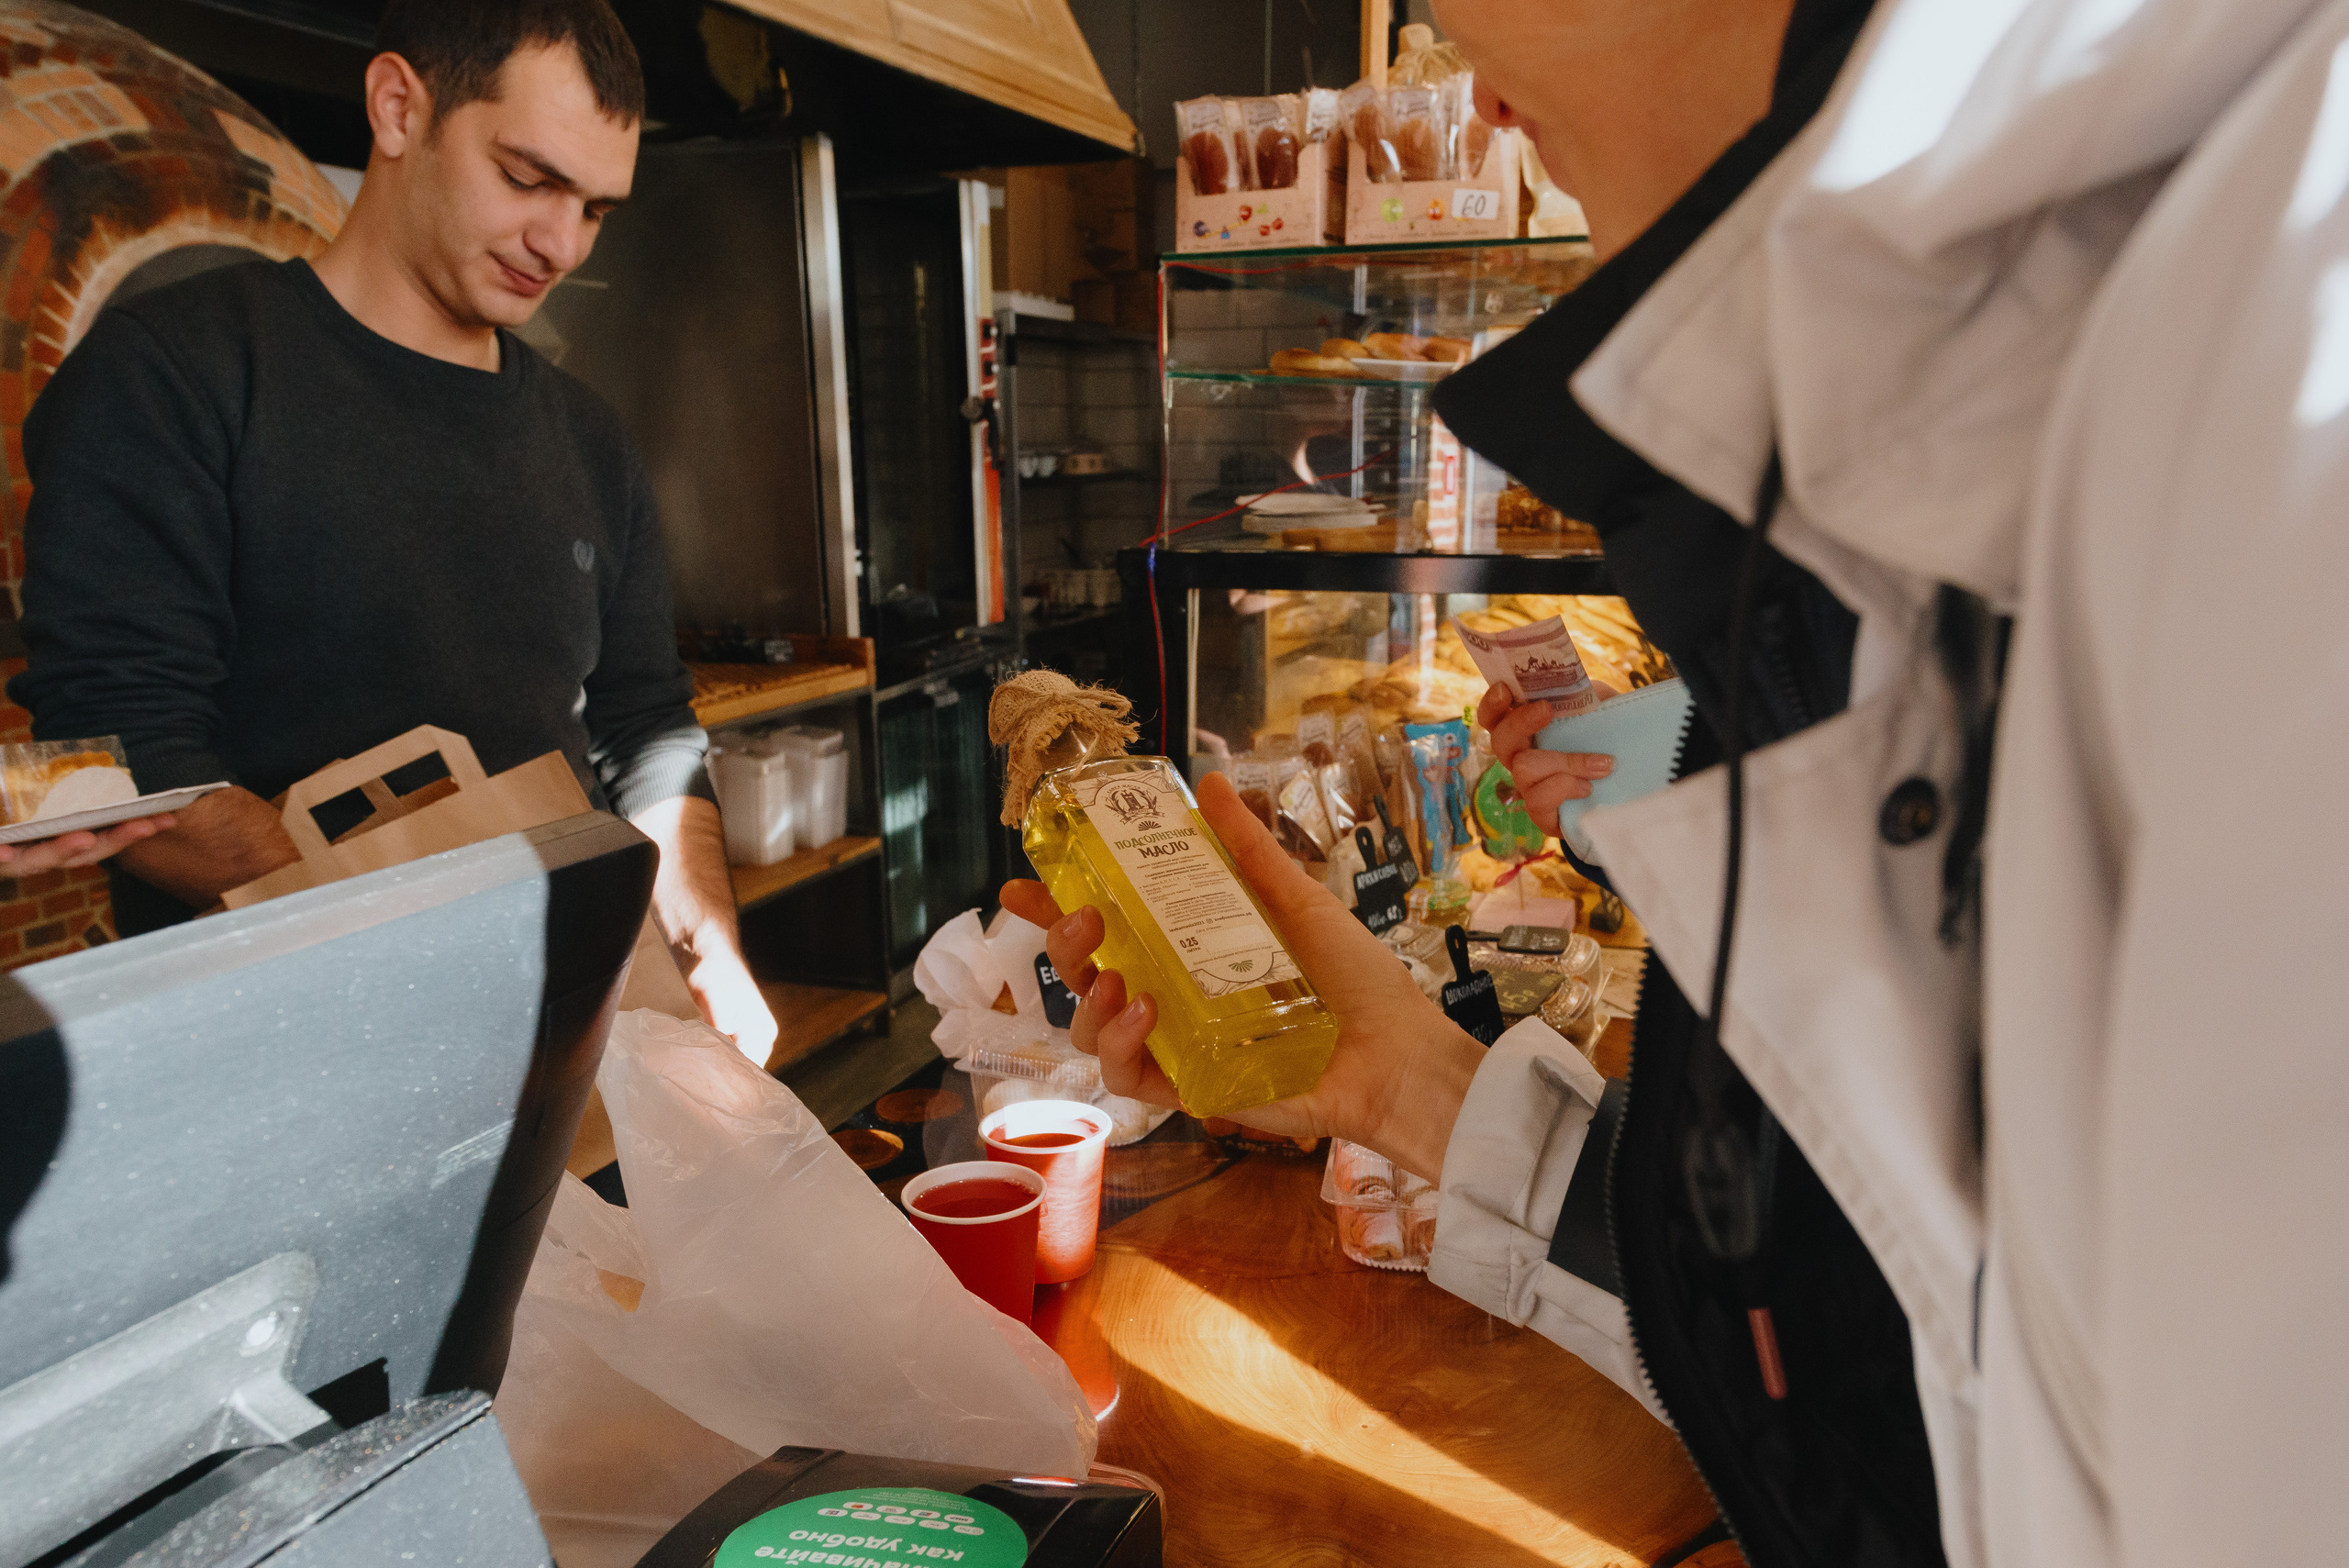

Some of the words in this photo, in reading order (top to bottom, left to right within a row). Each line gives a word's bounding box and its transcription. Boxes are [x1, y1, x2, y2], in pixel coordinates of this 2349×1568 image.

[1113, 828, 1198, 851] ПОДСОЛНЕЧНОЕ
[1138, 840, 1189, 859] МАСЛО
[1179, 937, 1198, 949] 0.25
[788, 1529, 904, 1551] удобно
[905, 1543, 964, 1562] как
